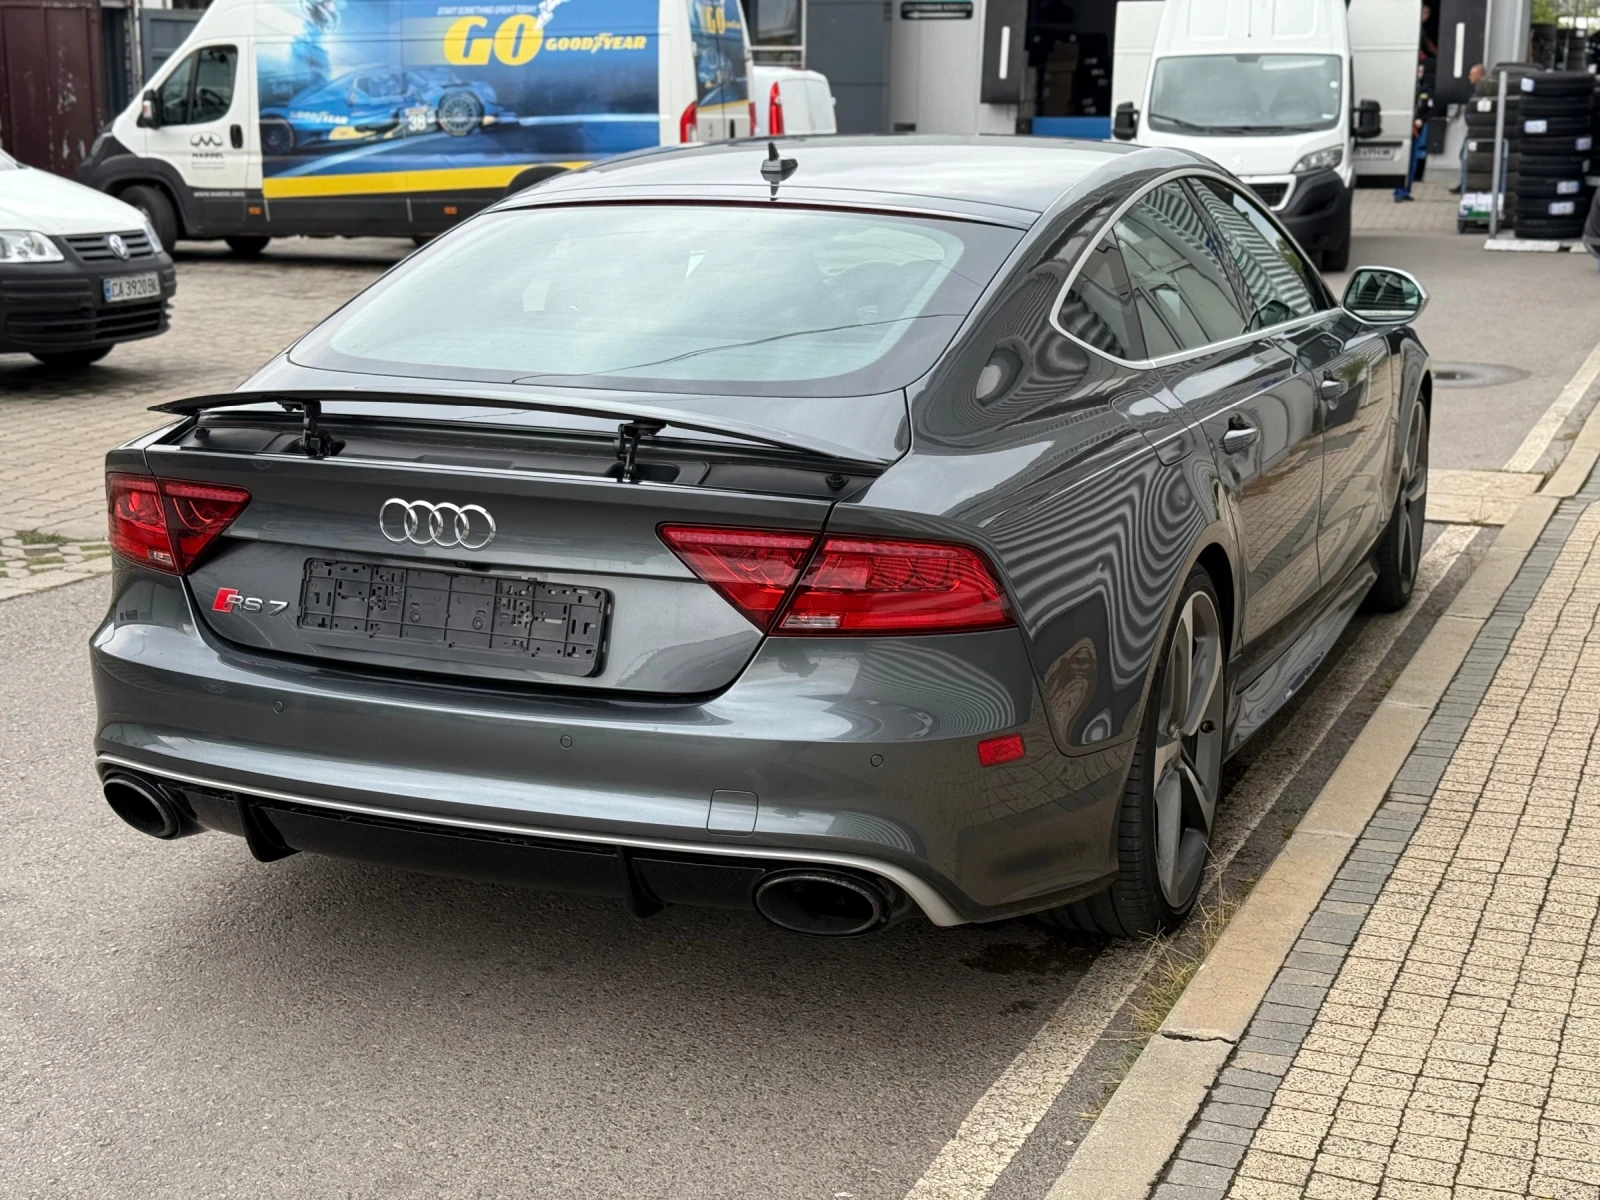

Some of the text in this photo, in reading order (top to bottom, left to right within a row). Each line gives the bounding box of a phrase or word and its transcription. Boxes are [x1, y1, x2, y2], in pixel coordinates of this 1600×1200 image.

[444, 14, 647, 66] GO GOODYEAR
[289, 110, 349, 125] GOODYEAR
[408, 114, 427, 131] 38
[125, 279, 147, 296] 3920
